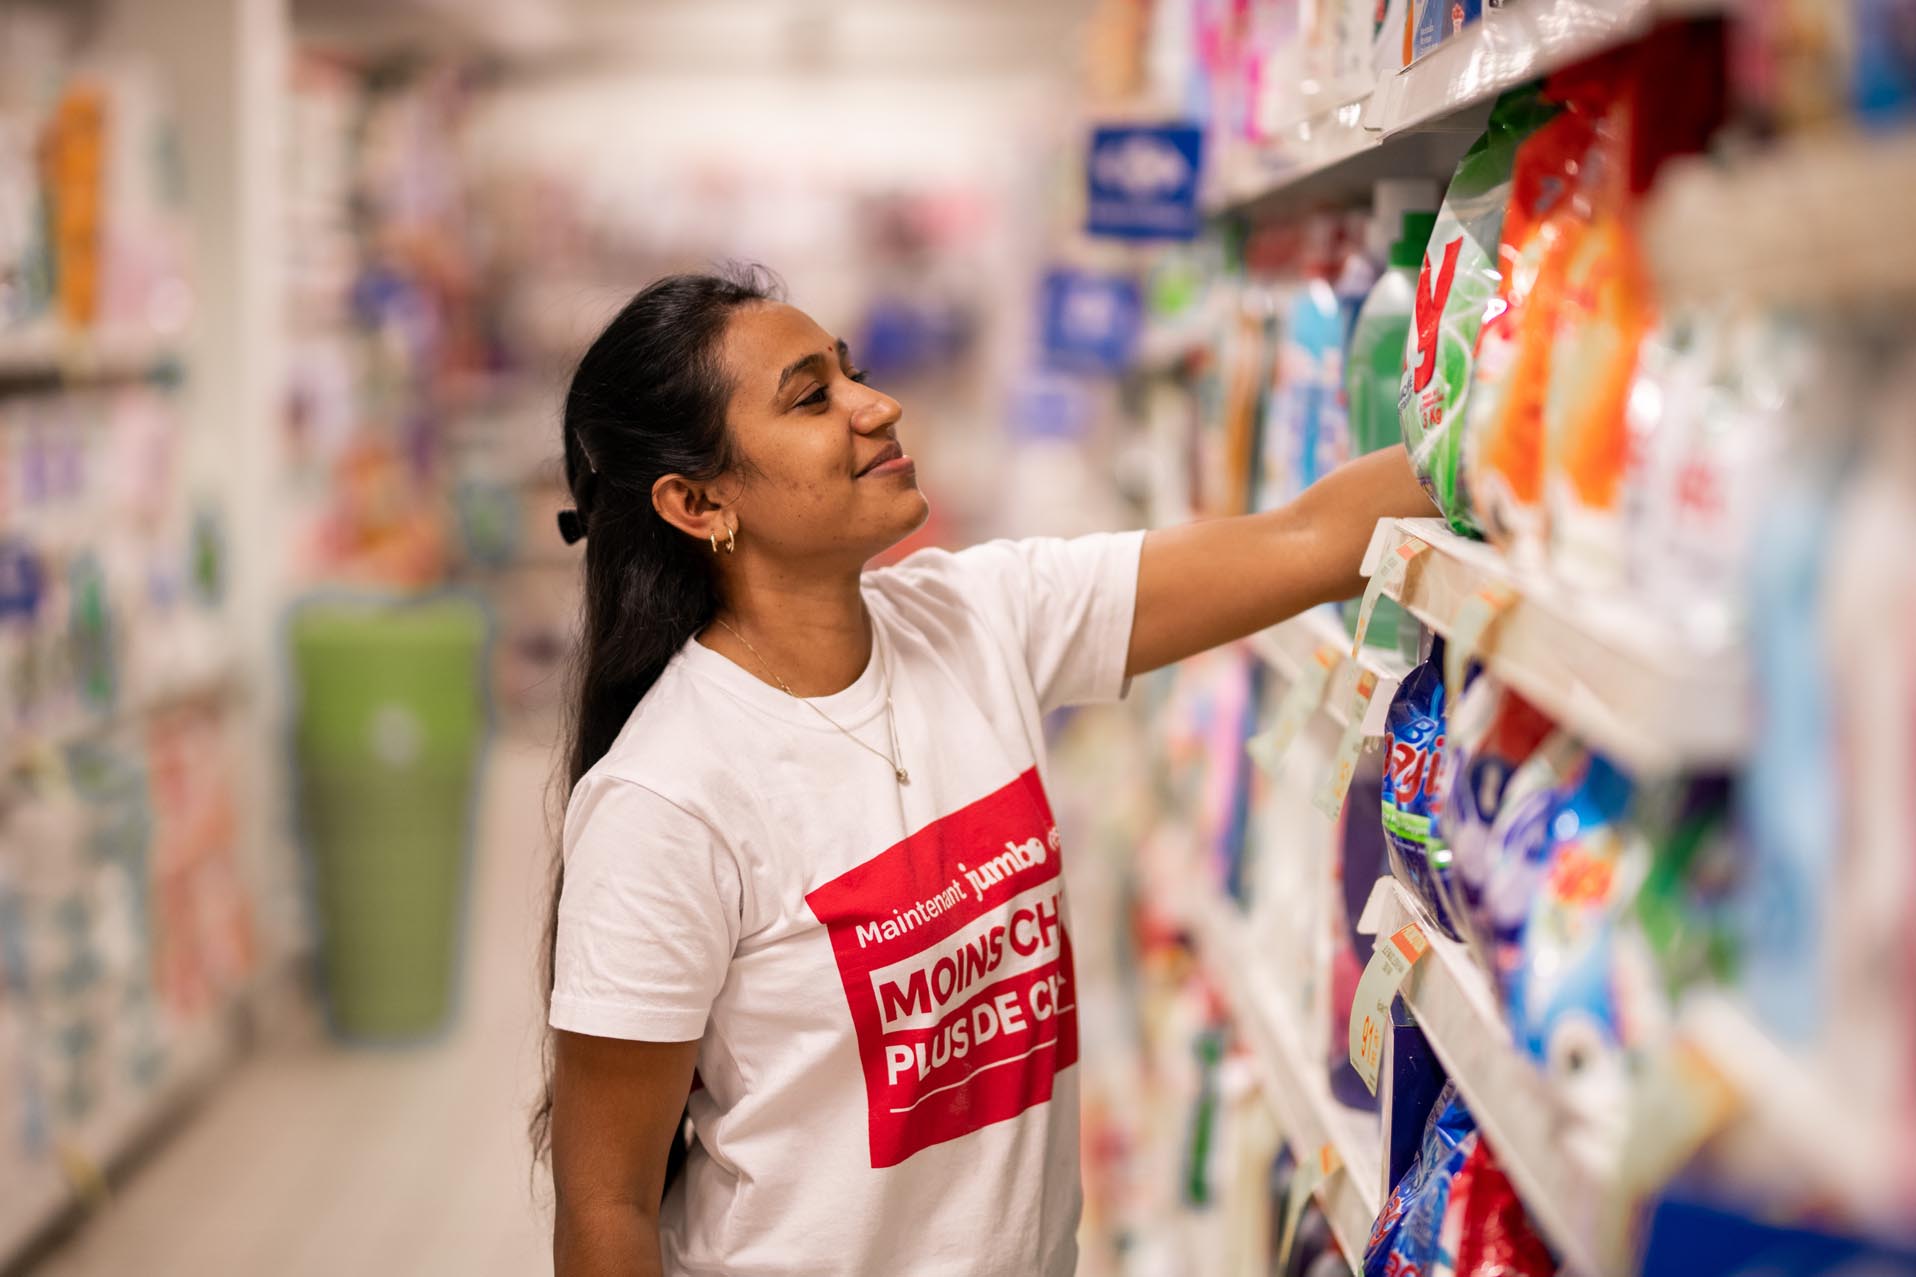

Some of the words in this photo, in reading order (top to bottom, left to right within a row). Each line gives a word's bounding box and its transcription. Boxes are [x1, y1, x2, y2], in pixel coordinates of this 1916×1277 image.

[855, 879, 967, 949] Maintenant
[957, 837, 1047, 902] jumbo
[879, 925, 1006, 1024] MOINS
[1008, 891, 1061, 957] CH
[885, 1016, 969, 1086] PLUS
[971, 990, 1028, 1046] DE
